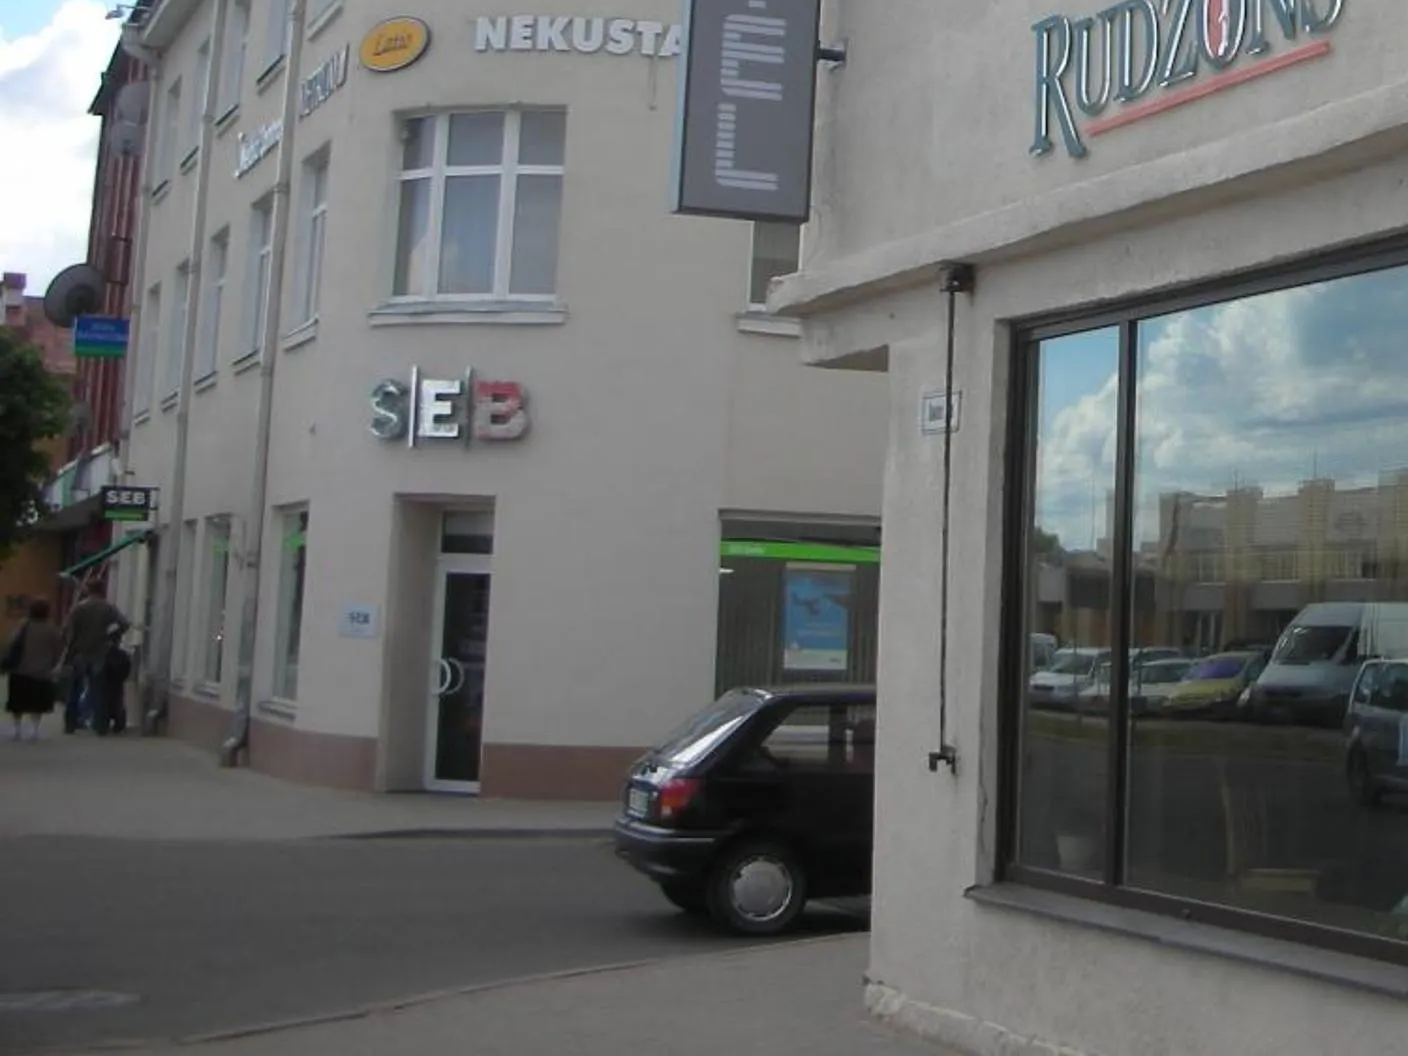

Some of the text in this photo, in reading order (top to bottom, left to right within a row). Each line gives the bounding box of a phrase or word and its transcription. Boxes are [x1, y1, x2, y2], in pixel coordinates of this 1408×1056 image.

[474, 14, 685, 57] NEKUSTA
[369, 375, 532, 442] SEB
[106, 489, 146, 505] SEB
